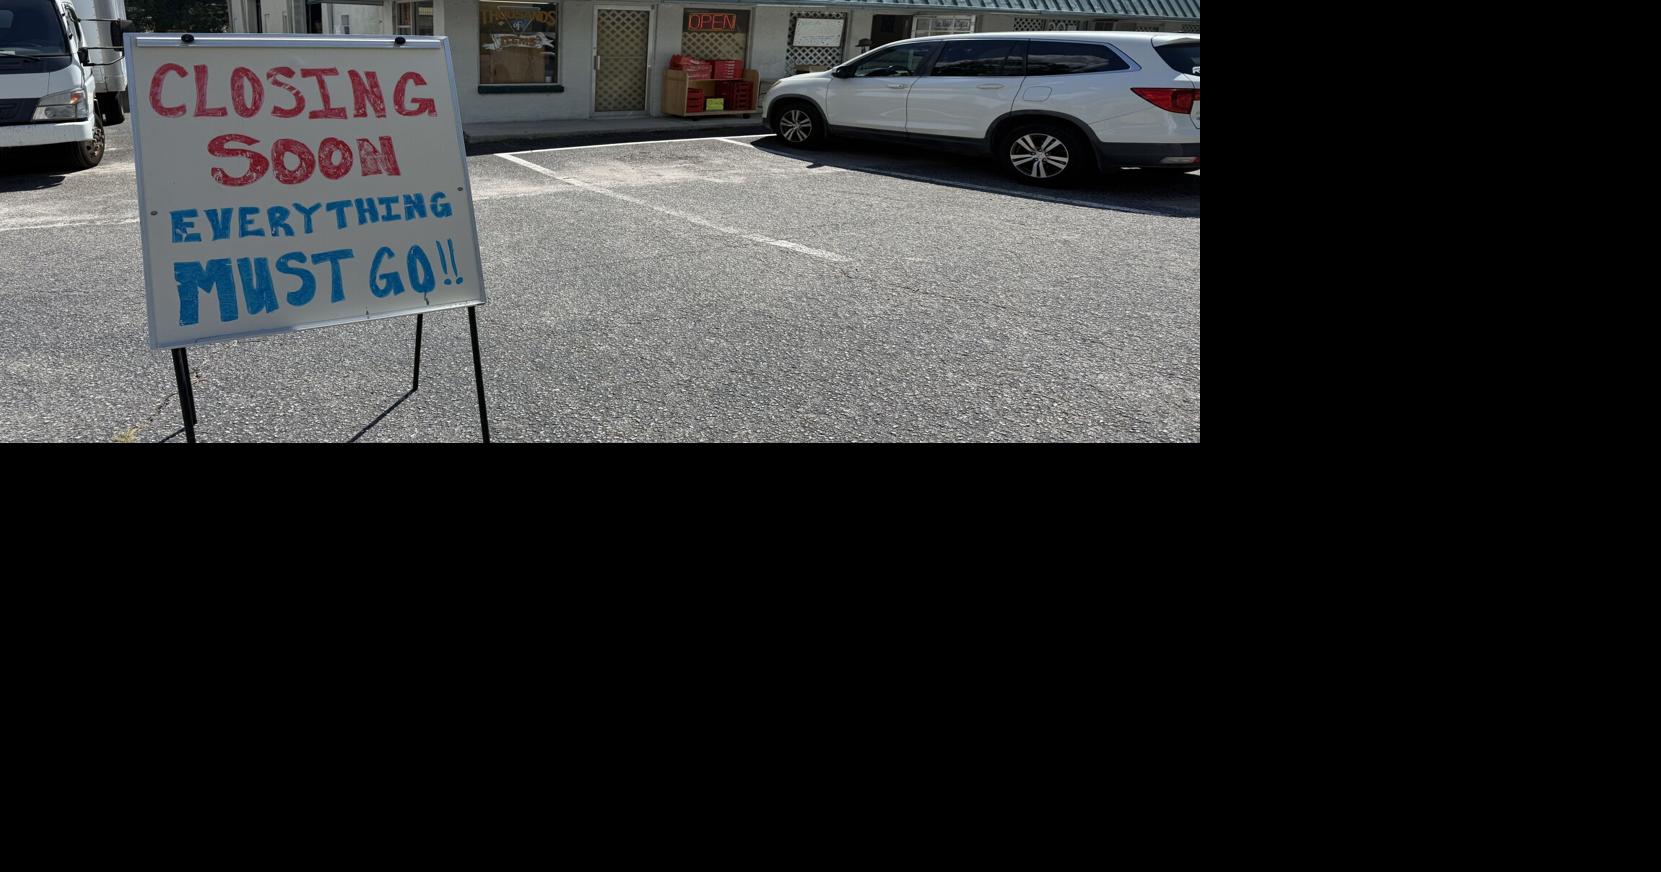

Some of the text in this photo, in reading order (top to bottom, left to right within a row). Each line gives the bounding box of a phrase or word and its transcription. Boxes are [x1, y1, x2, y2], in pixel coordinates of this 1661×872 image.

[688, 13, 736, 31] OPEN
[149, 62, 438, 120] CLOSING
[207, 133, 402, 187] SOON
[168, 191, 454, 244] EVERYTHING
[173, 238, 465, 327] MUST GO!!
